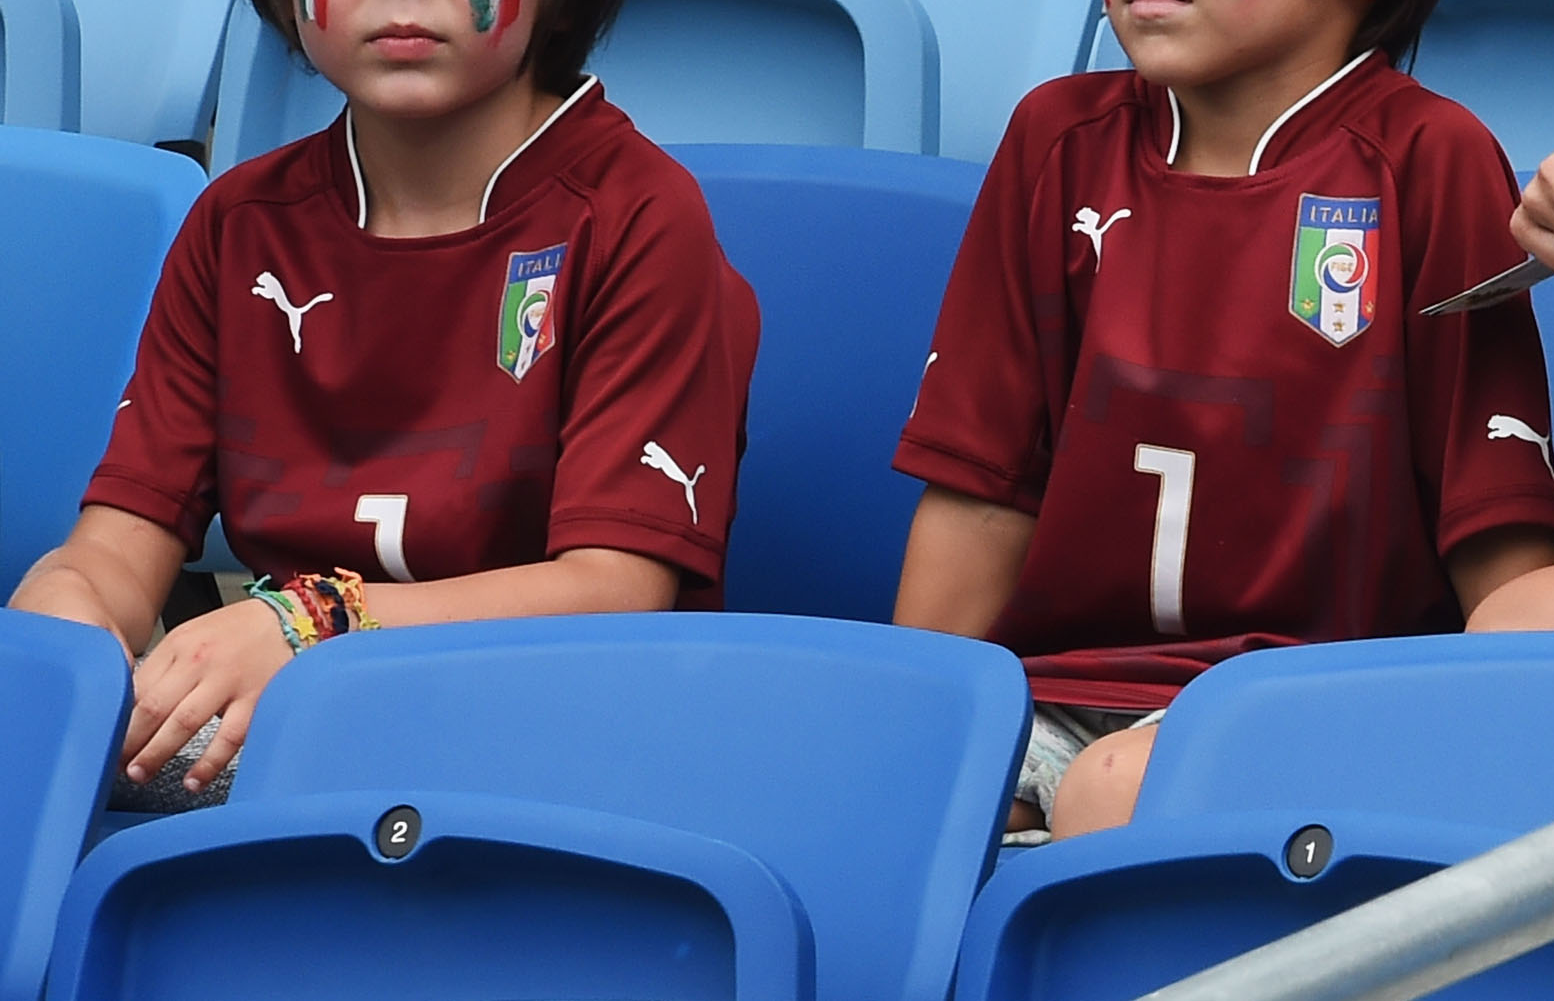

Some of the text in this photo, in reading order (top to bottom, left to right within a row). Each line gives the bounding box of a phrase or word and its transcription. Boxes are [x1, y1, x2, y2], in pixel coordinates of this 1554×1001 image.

[1309, 204, 1379, 224] ITALIA
[517, 253, 563, 278] ITALI
[354, 494, 416, 582] 1
[1134, 443, 1197, 636] 1
[391, 821, 407, 843] 2
[1305, 841, 1316, 863] 1
